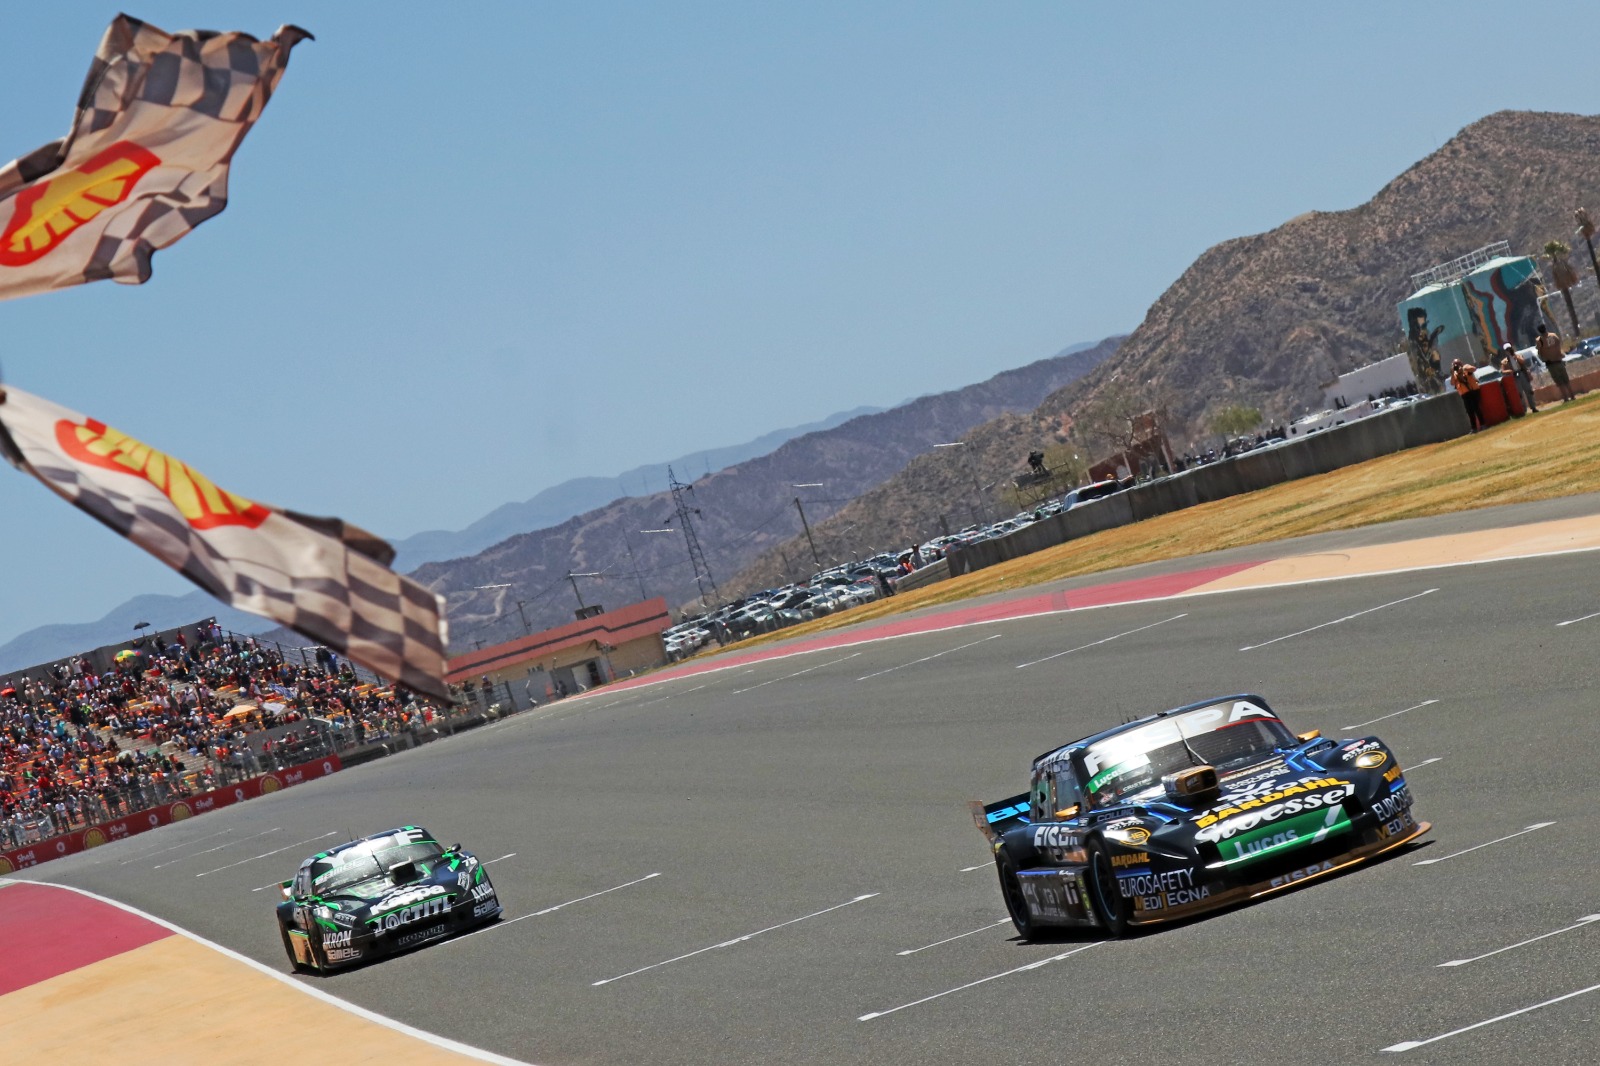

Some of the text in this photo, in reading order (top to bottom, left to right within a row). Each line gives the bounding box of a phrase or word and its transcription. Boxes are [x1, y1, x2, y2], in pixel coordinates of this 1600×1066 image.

[195, 797, 214, 810] Shell
[1194, 783, 1357, 844] Stoessel
[1195, 777, 1351, 829] BARDAHL
[110, 822, 128, 836] Shell
[17, 850, 36, 863] Shell
[1233, 828, 1301, 859] Lucas
[1111, 851, 1151, 868] BARDAHL
[1120, 866, 1195, 898] EUROSAFETY
[1270, 861, 1335, 888] FISPA
[369, 884, 447, 916] Kappa
[1134, 884, 1212, 912] MEDITECNA
